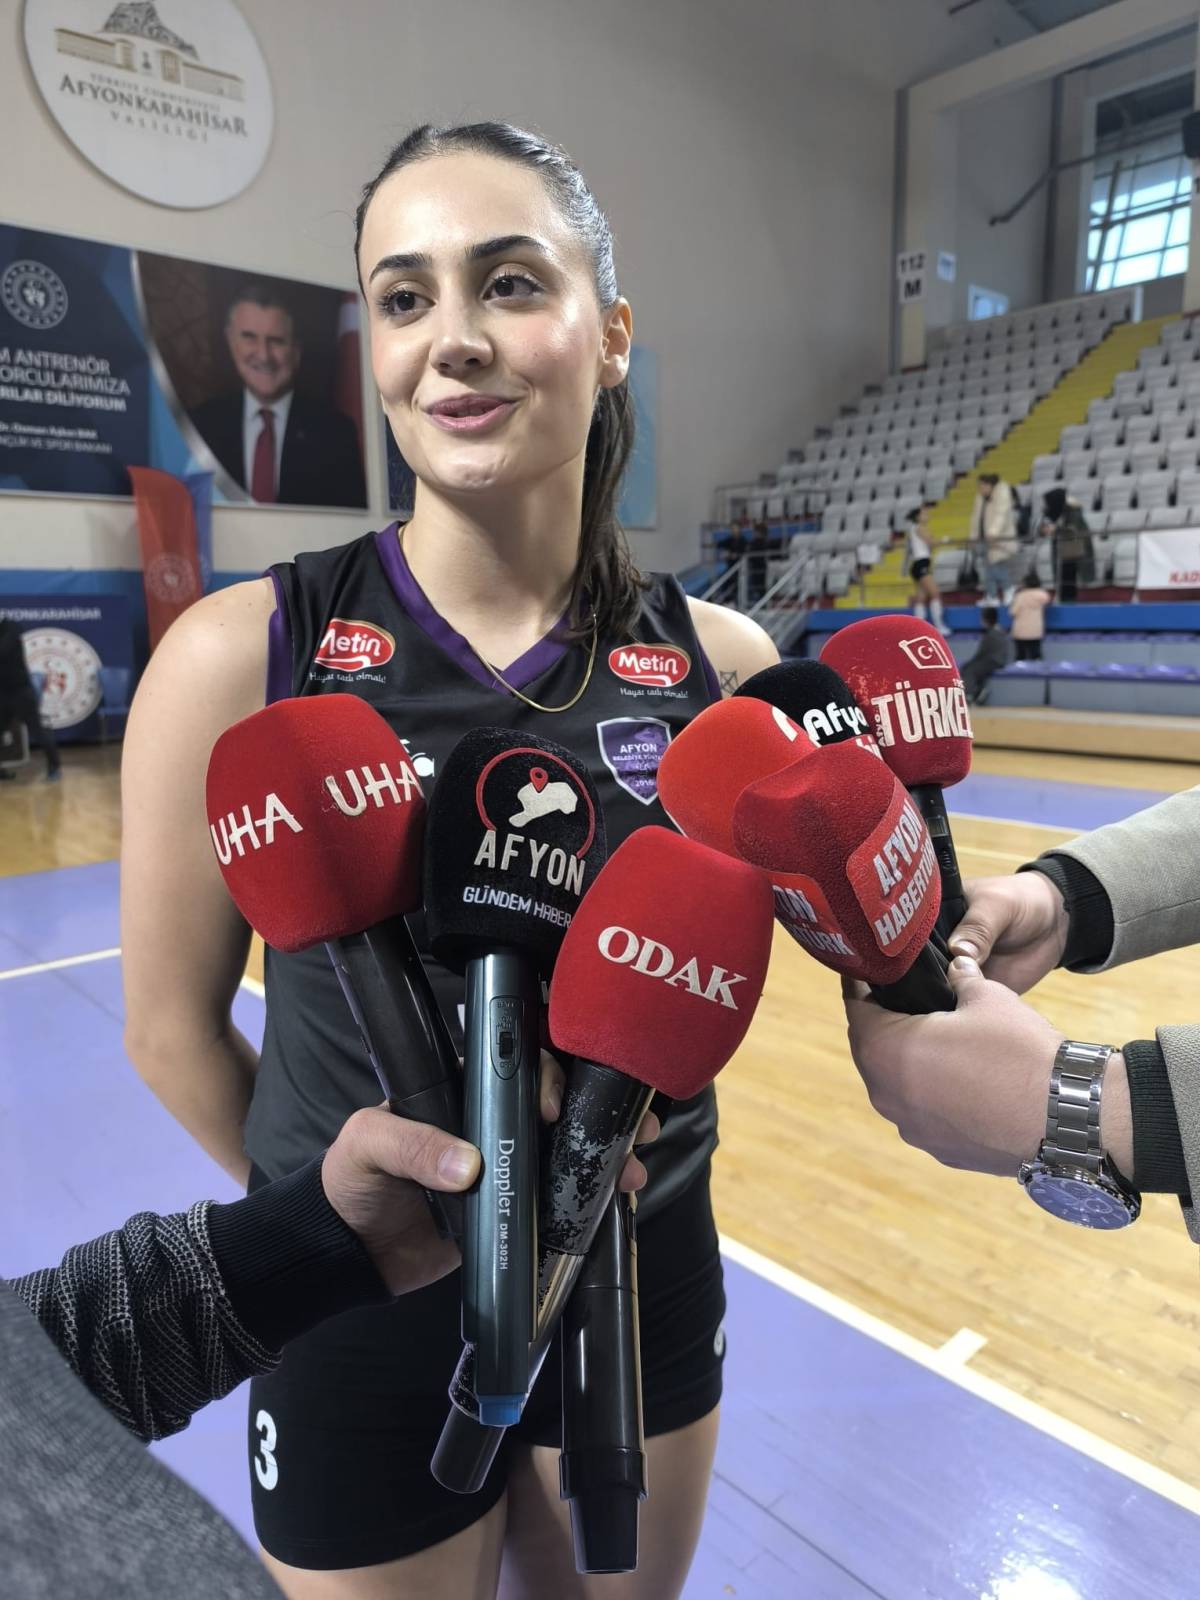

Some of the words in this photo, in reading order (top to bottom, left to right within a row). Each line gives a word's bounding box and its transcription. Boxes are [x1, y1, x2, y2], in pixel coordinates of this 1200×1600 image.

[59, 74, 248, 137] AFYONKARAHİSAR
[904, 279, 922, 299] M
[15, 349, 110, 376] ANTRENÖR
[618, 651, 679, 675] Metin
[620, 743, 657, 754] AFYON
[319, 761, 424, 816] UHA
[210, 792, 303, 865] UHA
[874, 799, 922, 896] AFYON
[474, 830, 585, 896] AFYON
[463, 886, 532, 914] GÜNDEM
[533, 901, 571, 928] HABER
[598, 926, 747, 1010] ODAK
[494, 1139, 515, 1217] Doppler
[499, 1223, 509, 1270] DM-302H
[254, 1409, 279, 1491] 3
